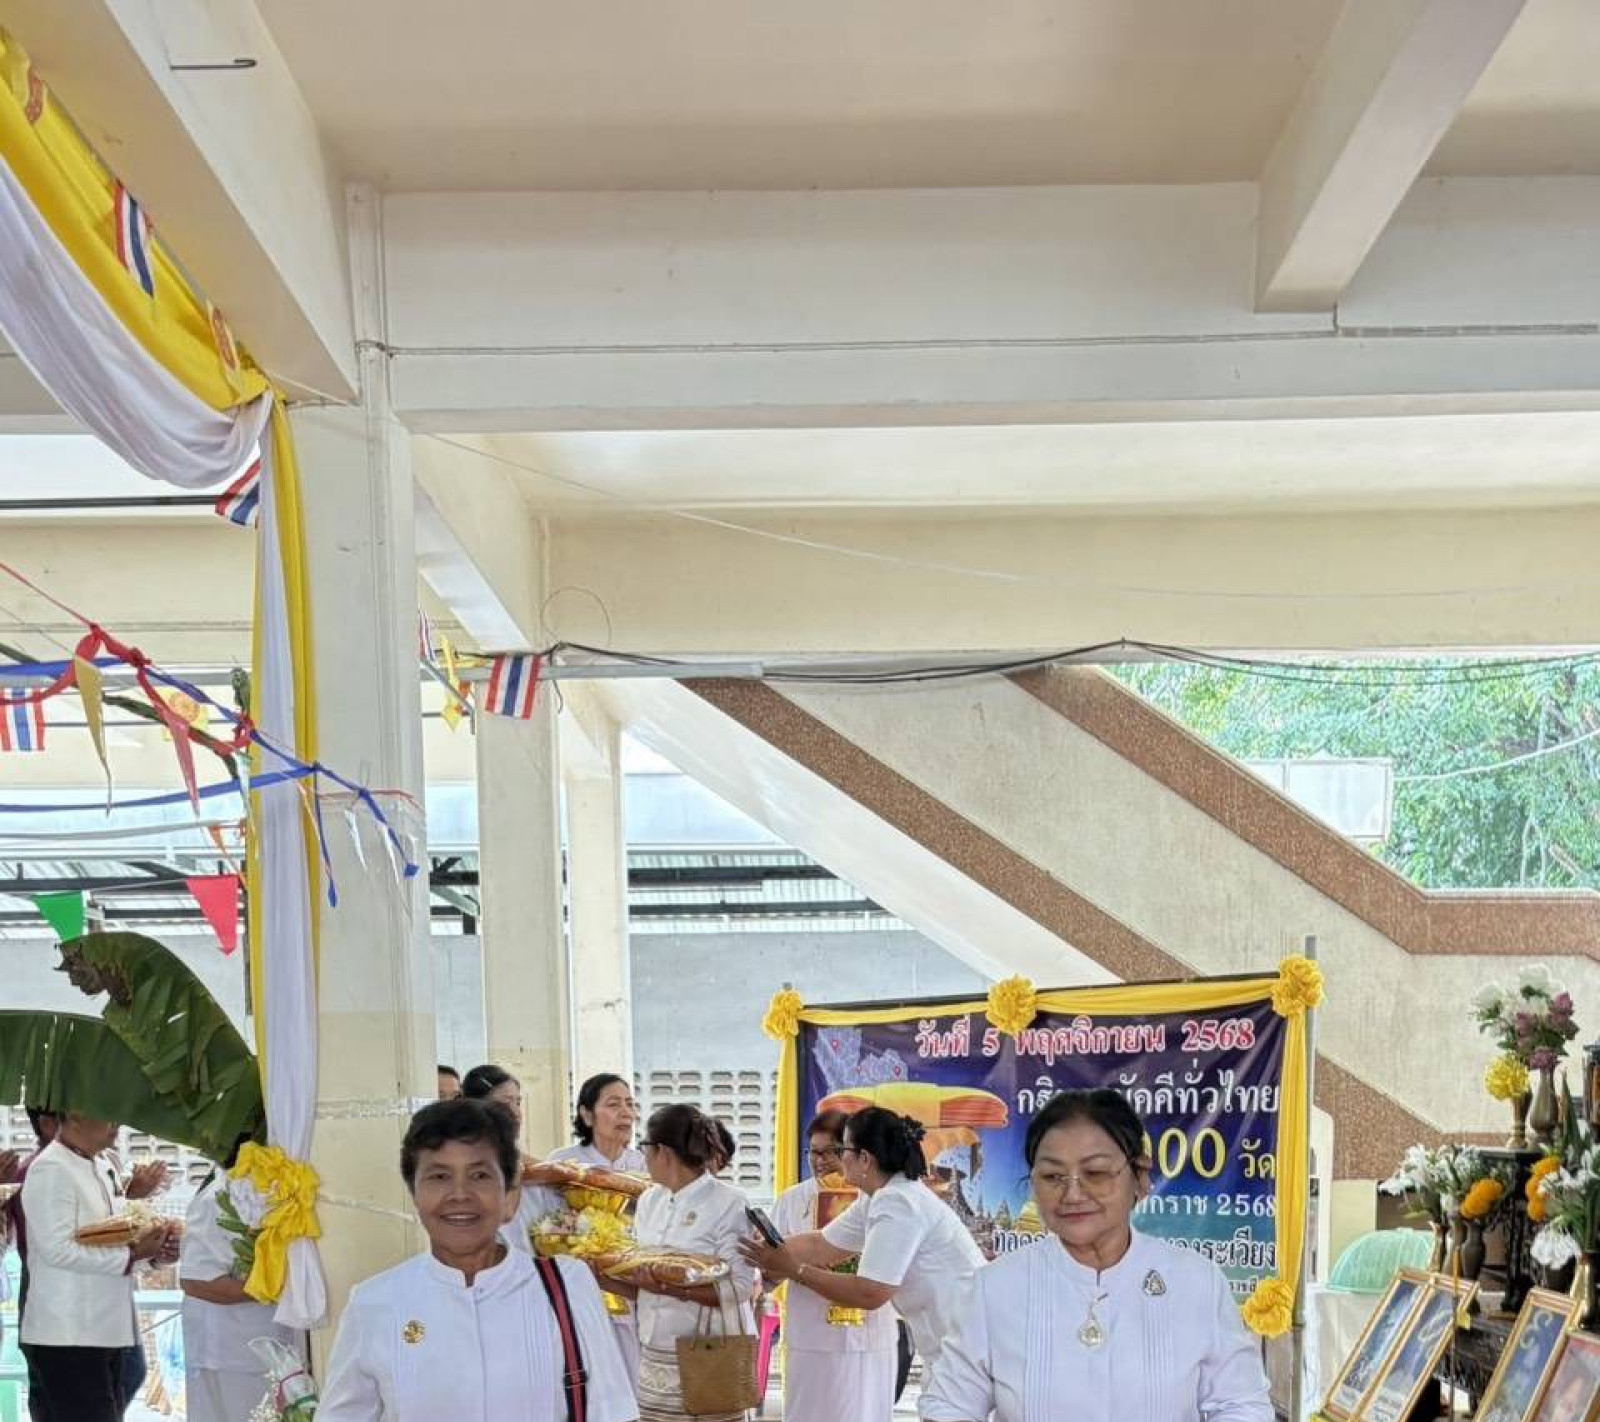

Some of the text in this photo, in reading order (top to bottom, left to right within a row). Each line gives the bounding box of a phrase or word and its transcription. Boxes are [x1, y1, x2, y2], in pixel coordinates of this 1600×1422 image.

[914, 1014, 1256, 1066] วันที่ 5 พฤศจิกายน 2568
[1238, 1137, 1275, 1179] วัด
[1216, 1192, 1276, 1217] 2568
